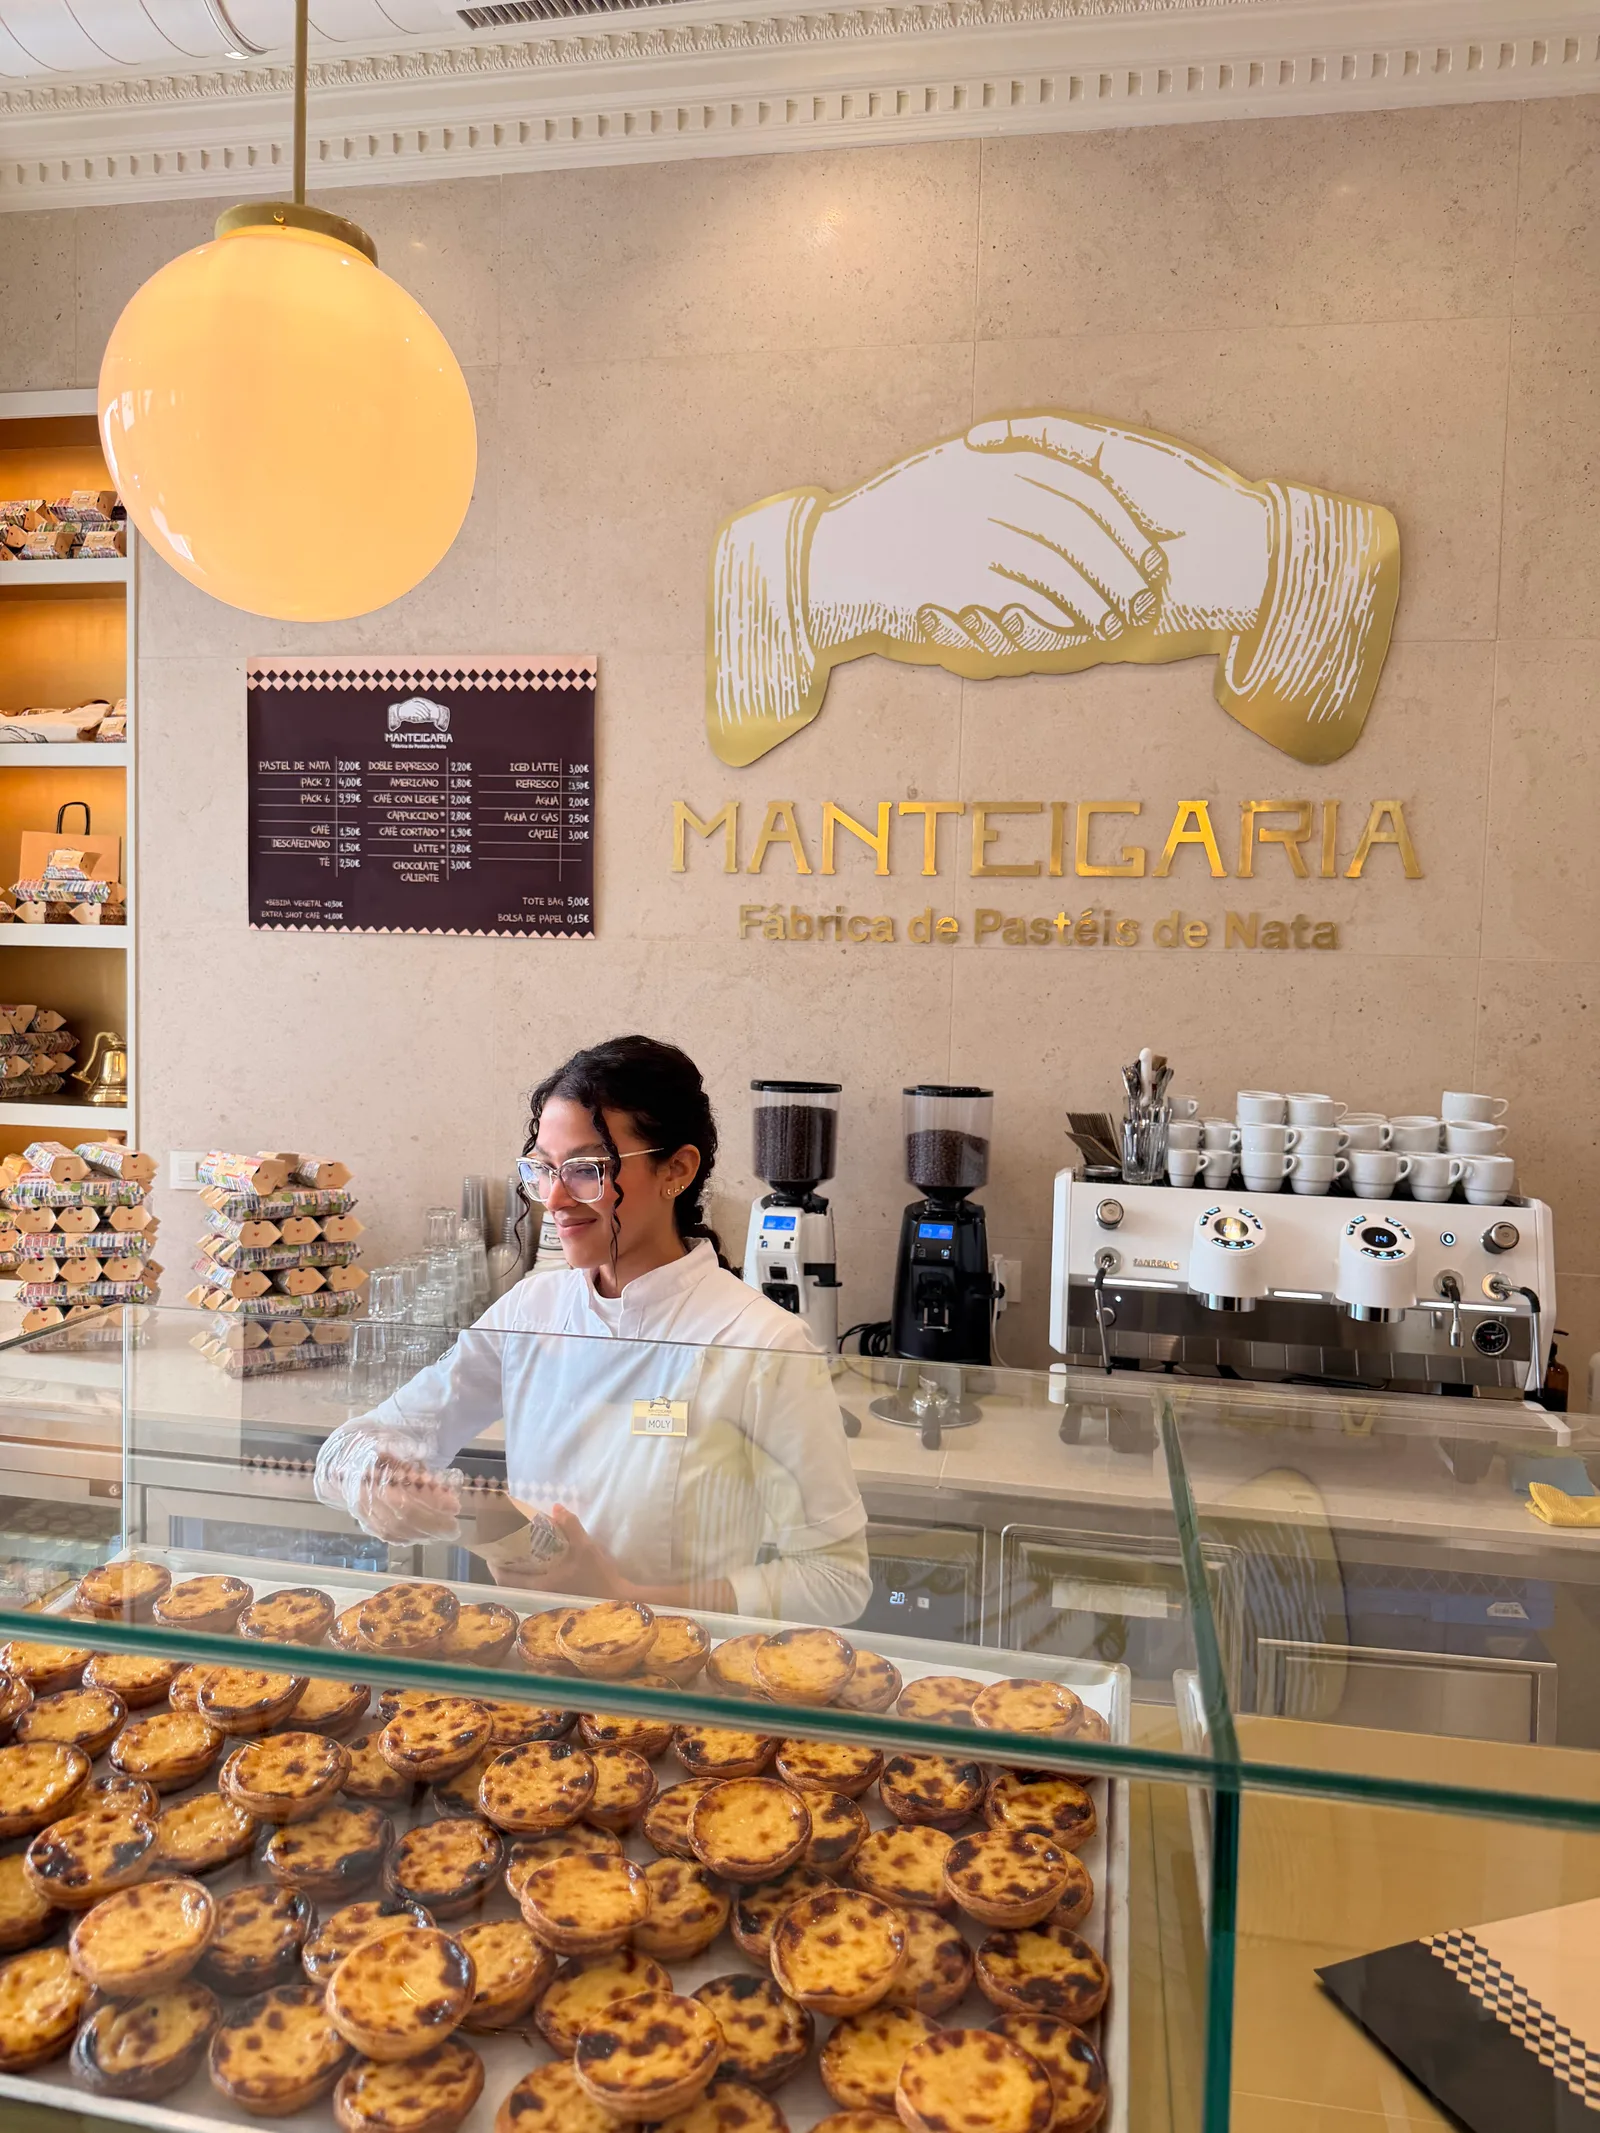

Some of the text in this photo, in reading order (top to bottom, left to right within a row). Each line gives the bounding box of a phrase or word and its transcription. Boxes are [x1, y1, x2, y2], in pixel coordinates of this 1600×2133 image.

[384, 733, 454, 743] MANTEIGARIA
[259, 760, 361, 773] PASTEL DE NATA 2,00€
[368, 761, 472, 773] DOBLE EXPRESSO 2,20€
[510, 762, 589, 775] ICED LATTE 3,00€
[301, 777, 362, 789] PACK 2 4,00€
[390, 778, 472, 790] AMERICANO 1,80€
[515, 779, 559, 789] REFRESCO
[301, 793, 362, 805] PACK 6 9,99€
[373, 793, 392, 804] CAFÉ
[395, 795, 413, 804] CON
[450, 795, 472, 806] 2,00€
[535, 795, 590, 808] AGUA 2,00€
[450, 811, 472, 822] 2,80€
[504, 812, 590, 825] AGUA C/ GAS 2,50€
[310, 824, 361, 838] CAFÉ 1,50€
[379, 826, 398, 837] CAFÉ
[528, 828, 590, 841] CAPILÉ 3,00€
[671, 799, 1425, 879] MANTEIGARIA
[272, 839, 361, 854] DESCAFEINADO 1,50€
[450, 844, 472, 855] 2,80€
[319, 856, 361, 869] TÉ 2,50€
[450, 860, 472, 872] 3,00€
[400, 873, 440, 882] CALIENTE
[294, 899, 322, 908] VEGETAL
[522, 896, 590, 908] TOTE BAG 5,00€
[497, 913, 590, 925] BOLSA DE PAPEL 0,15€
[738, 903, 1341, 950] Fábrica de Pastéis de Nata
[648, 1419, 671, 1429] MOLY
[889, 1591, 905, 1604] 20
